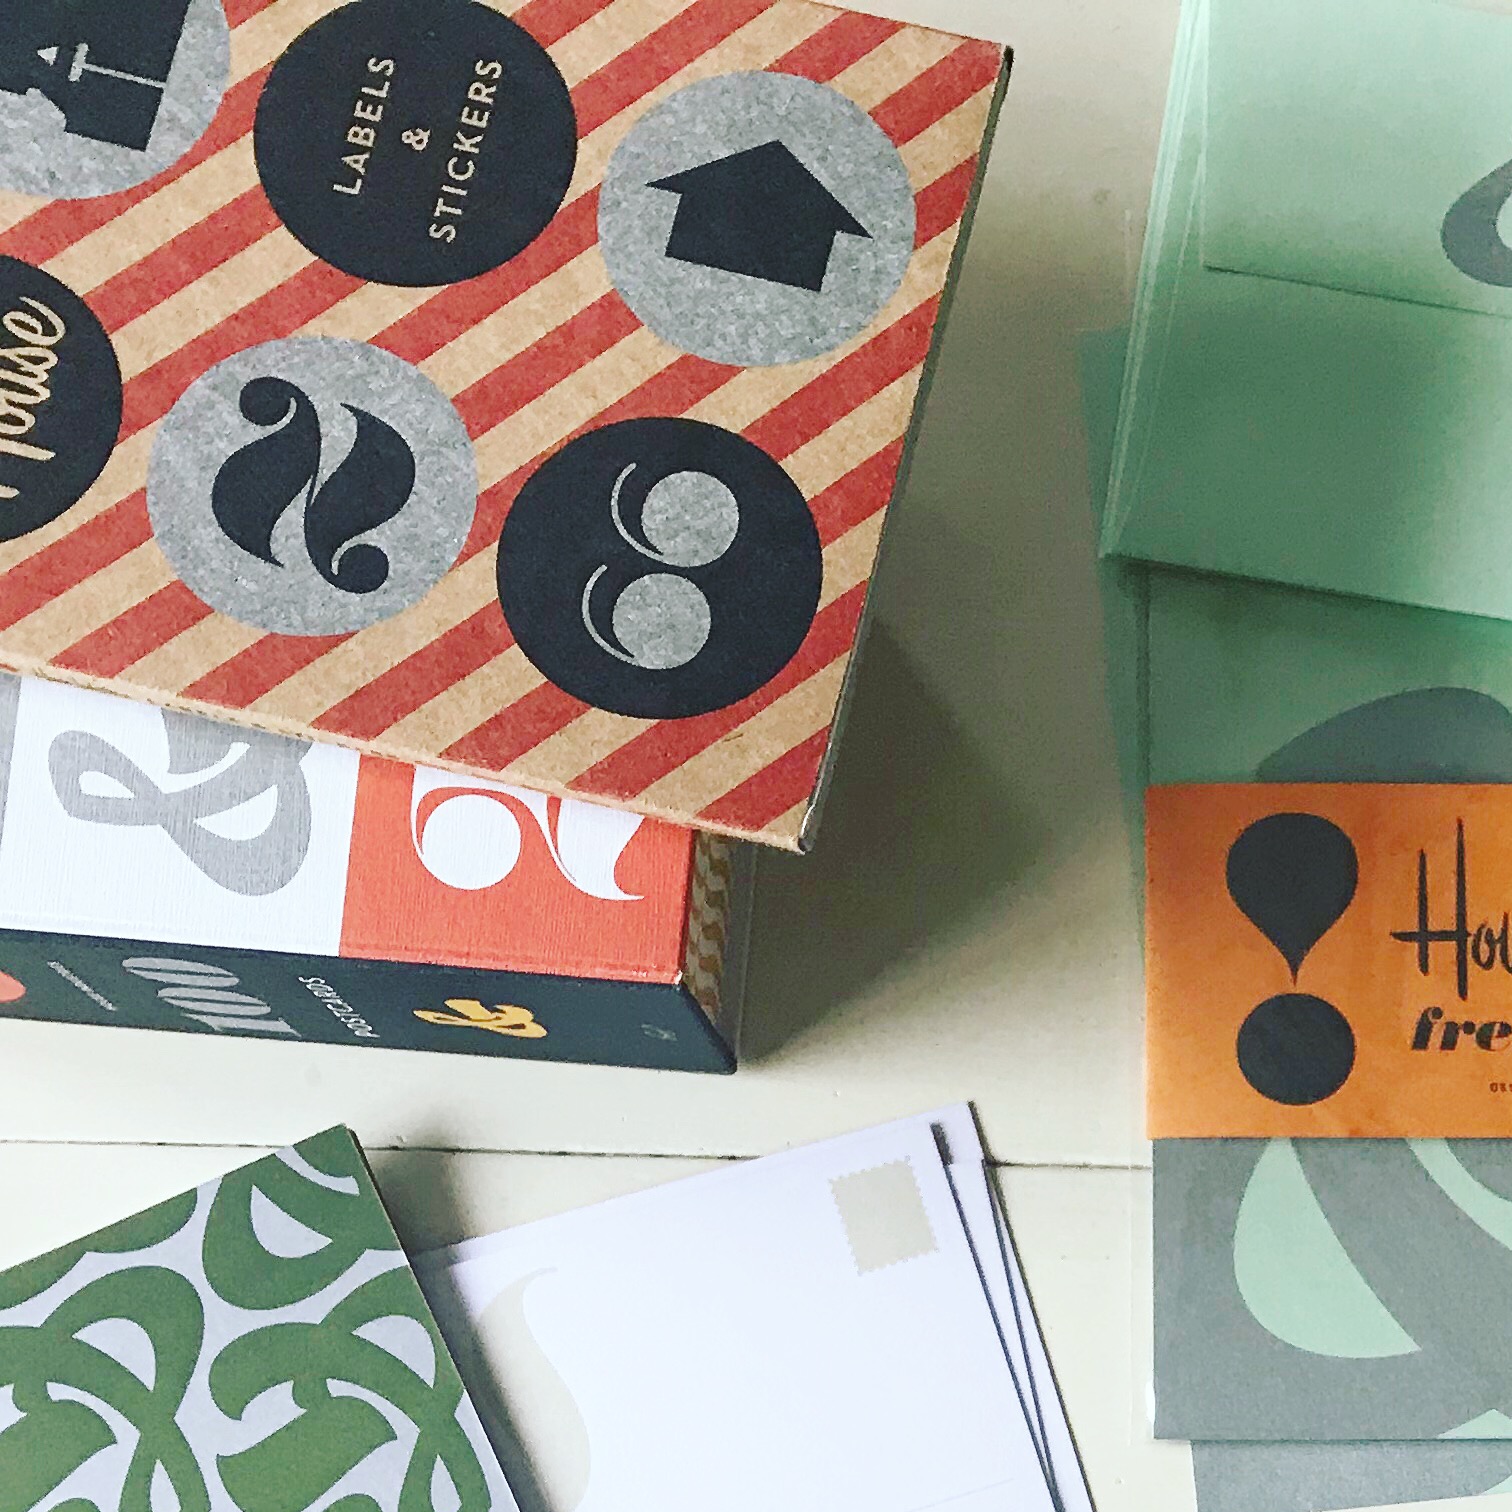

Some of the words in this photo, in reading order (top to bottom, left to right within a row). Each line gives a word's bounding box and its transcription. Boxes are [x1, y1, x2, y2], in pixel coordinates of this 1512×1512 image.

[332, 57, 396, 195] LABELS
[401, 127, 431, 151] &
[429, 59, 503, 243] STICKERS
[121, 955, 301, 1037] 100
[297, 974, 381, 1038] POSTCARDS
